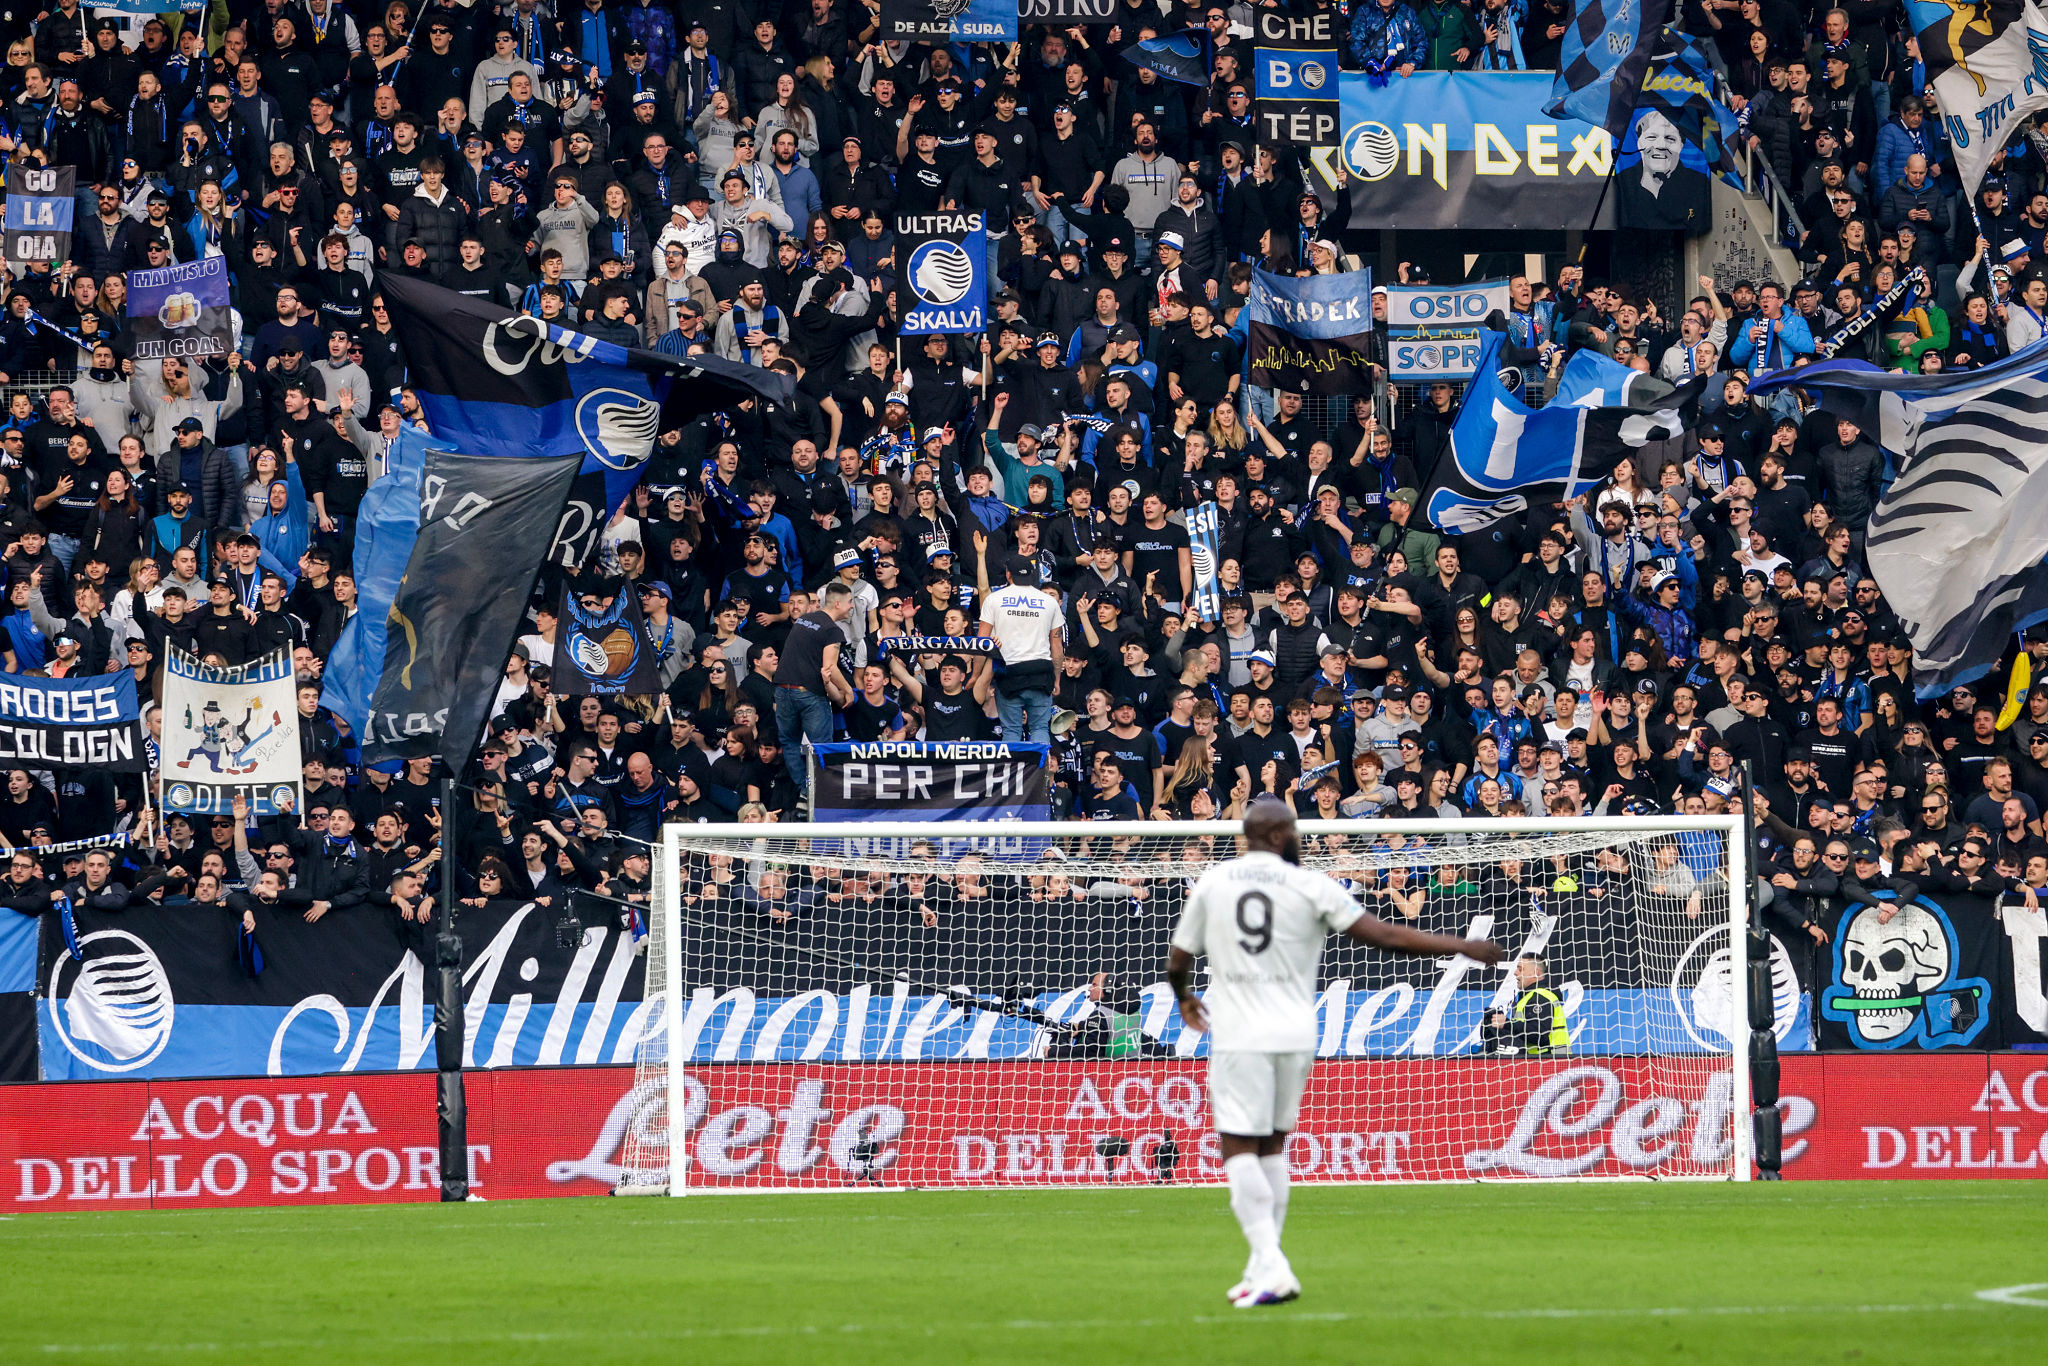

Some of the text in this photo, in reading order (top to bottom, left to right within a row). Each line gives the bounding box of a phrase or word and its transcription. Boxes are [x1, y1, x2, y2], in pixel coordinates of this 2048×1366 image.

[894, 19, 1005, 35] DE ALZÀ SURA
[1262, 13, 1332, 41] CHE
[1264, 107, 1335, 142] TÉP
[23, 201, 54, 225] LA
[897, 214, 982, 235] ULTRAS
[134, 259, 220, 288] MAI VISTO
[904, 305, 981, 331] SKALVÌ
[1410, 294, 1488, 319] OSIO
[136, 337, 224, 359] UN GOAL
[841, 550, 856, 561] 1907
[1000, 595, 1046, 609] SOMET
[1007, 610, 1040, 618] CREBERG
[885, 636, 995, 652] BERGAMO
[850, 743, 1011, 760] NAPOLI MERDA
[843, 762, 1025, 800] PER CHI
[195, 785, 222, 813] DI
[39, 832, 126, 855] MERDA
[1237, 889, 1273, 955] 9
[1066, 1076, 1203, 1127] ACQ
[1971, 1069, 2048, 1112] AC
[130, 1091, 377, 1146] ACQUA
[545, 1073, 906, 1185] Lete
[1463, 1066, 1817, 1177] Lete
[953, 1130, 1410, 1177] DELLO SORT
[14, 1144, 491, 1200] DELLO SPORT
